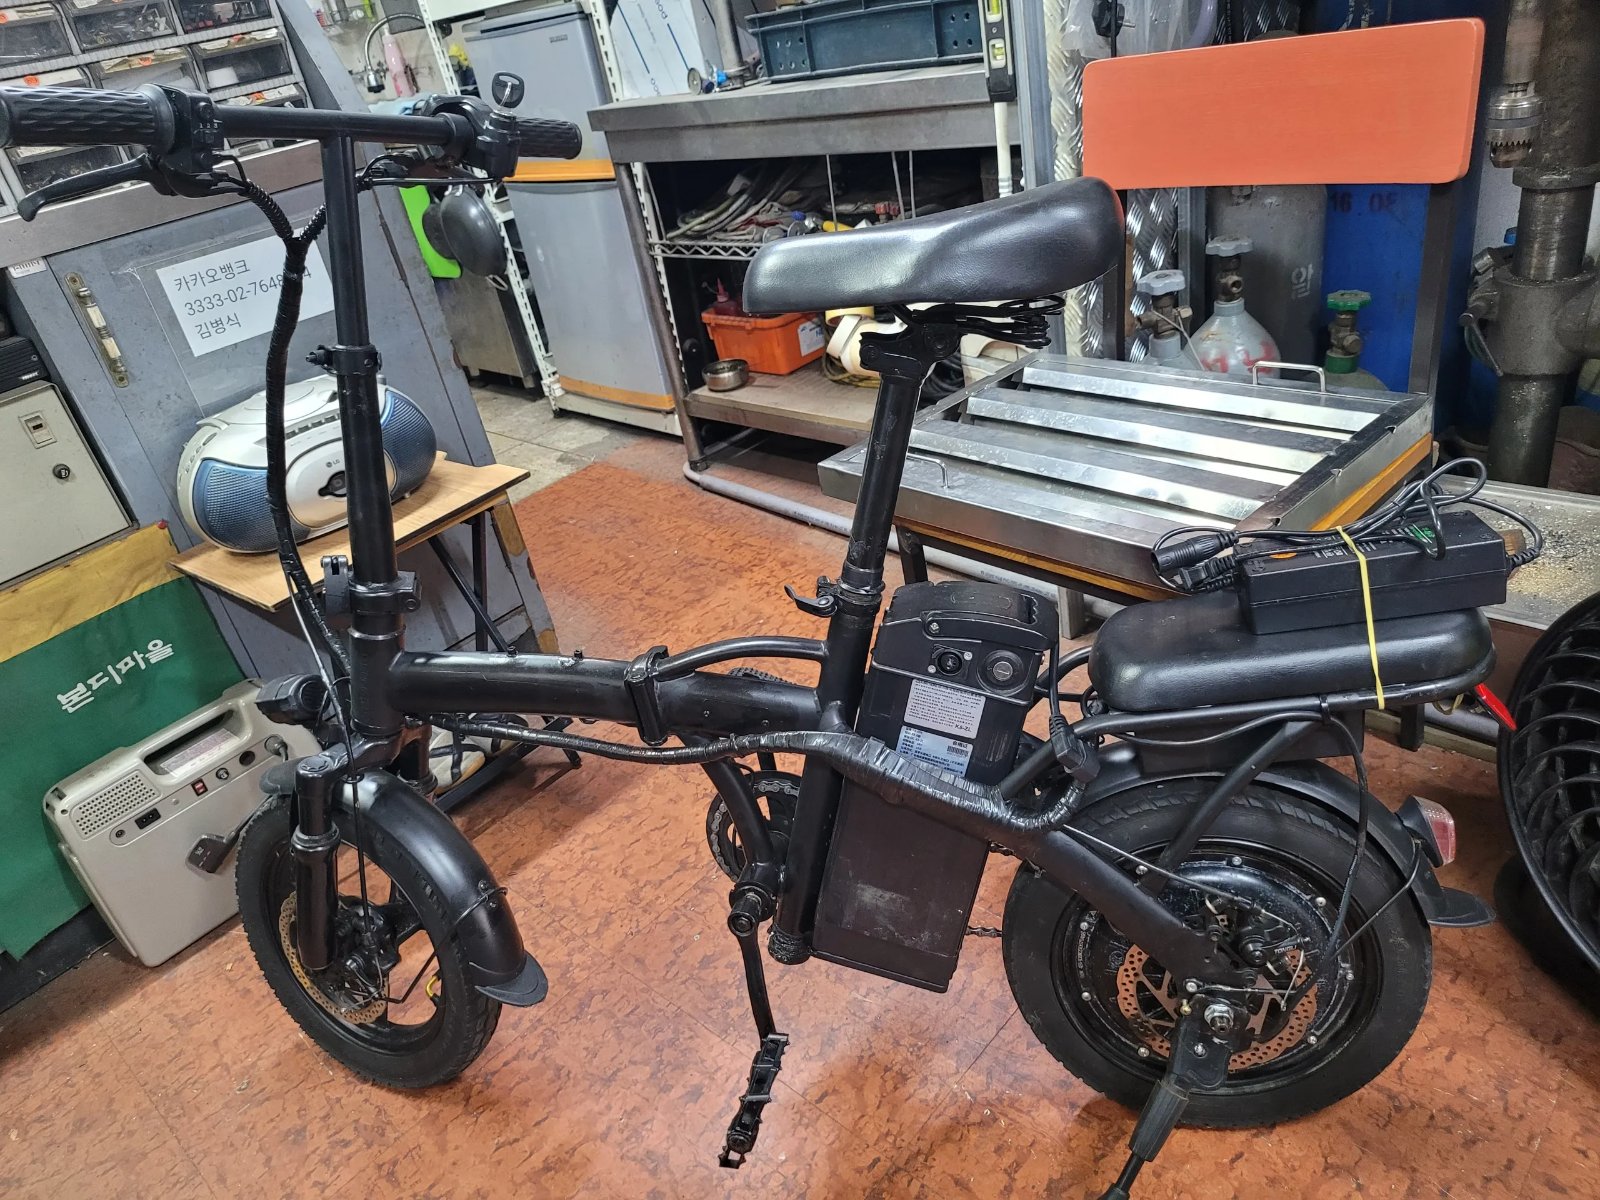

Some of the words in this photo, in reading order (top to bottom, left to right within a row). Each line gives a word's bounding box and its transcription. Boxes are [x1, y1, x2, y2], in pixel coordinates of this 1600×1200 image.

[174, 259, 250, 292] 카카오뱅크
[184, 266, 312, 316] 3333-02-76484
[194, 312, 242, 340] 김병식
[57, 639, 175, 714] 본디마을
